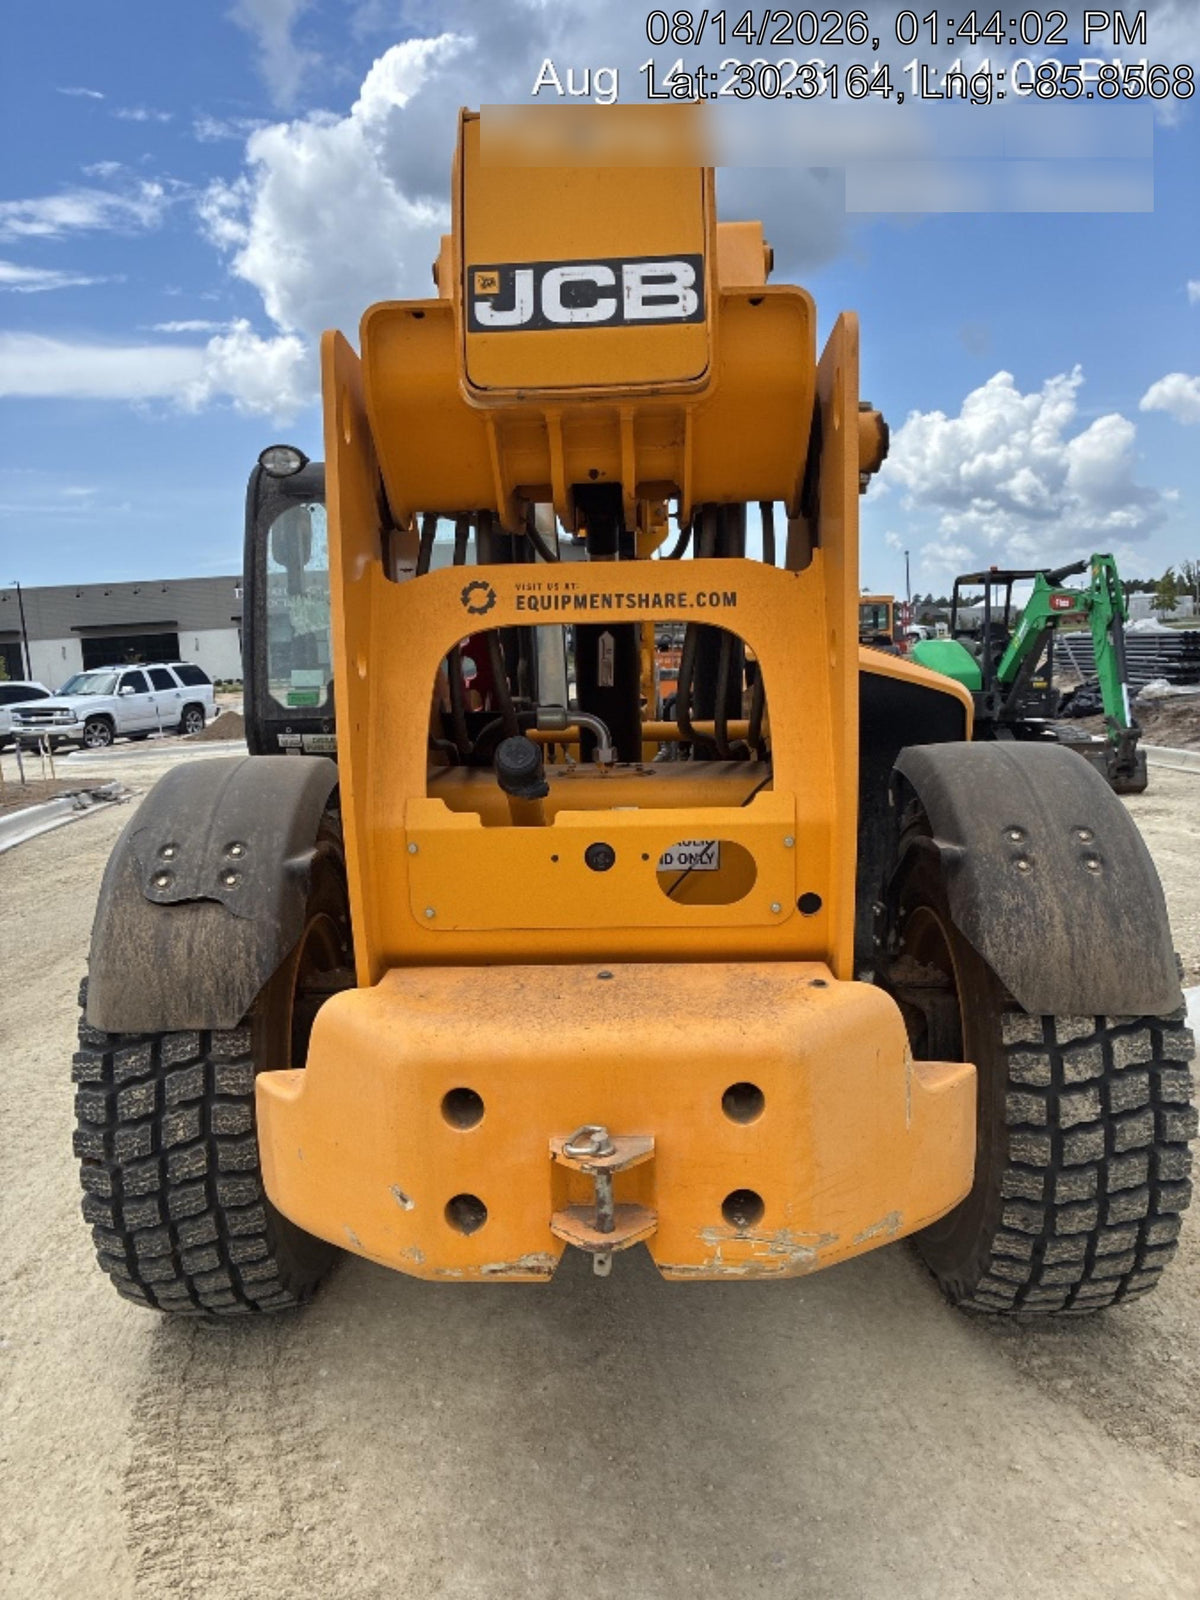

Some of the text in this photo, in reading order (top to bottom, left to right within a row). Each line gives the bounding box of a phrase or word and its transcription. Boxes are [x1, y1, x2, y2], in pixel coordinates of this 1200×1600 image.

[474, 261, 699, 326] JCB
[515, 583, 542, 591] VISIT
[547, 583, 560, 591] US
[516, 592, 737, 611] EQUIPMENTSHARE.COM
[678, 851, 715, 865] ONLY
